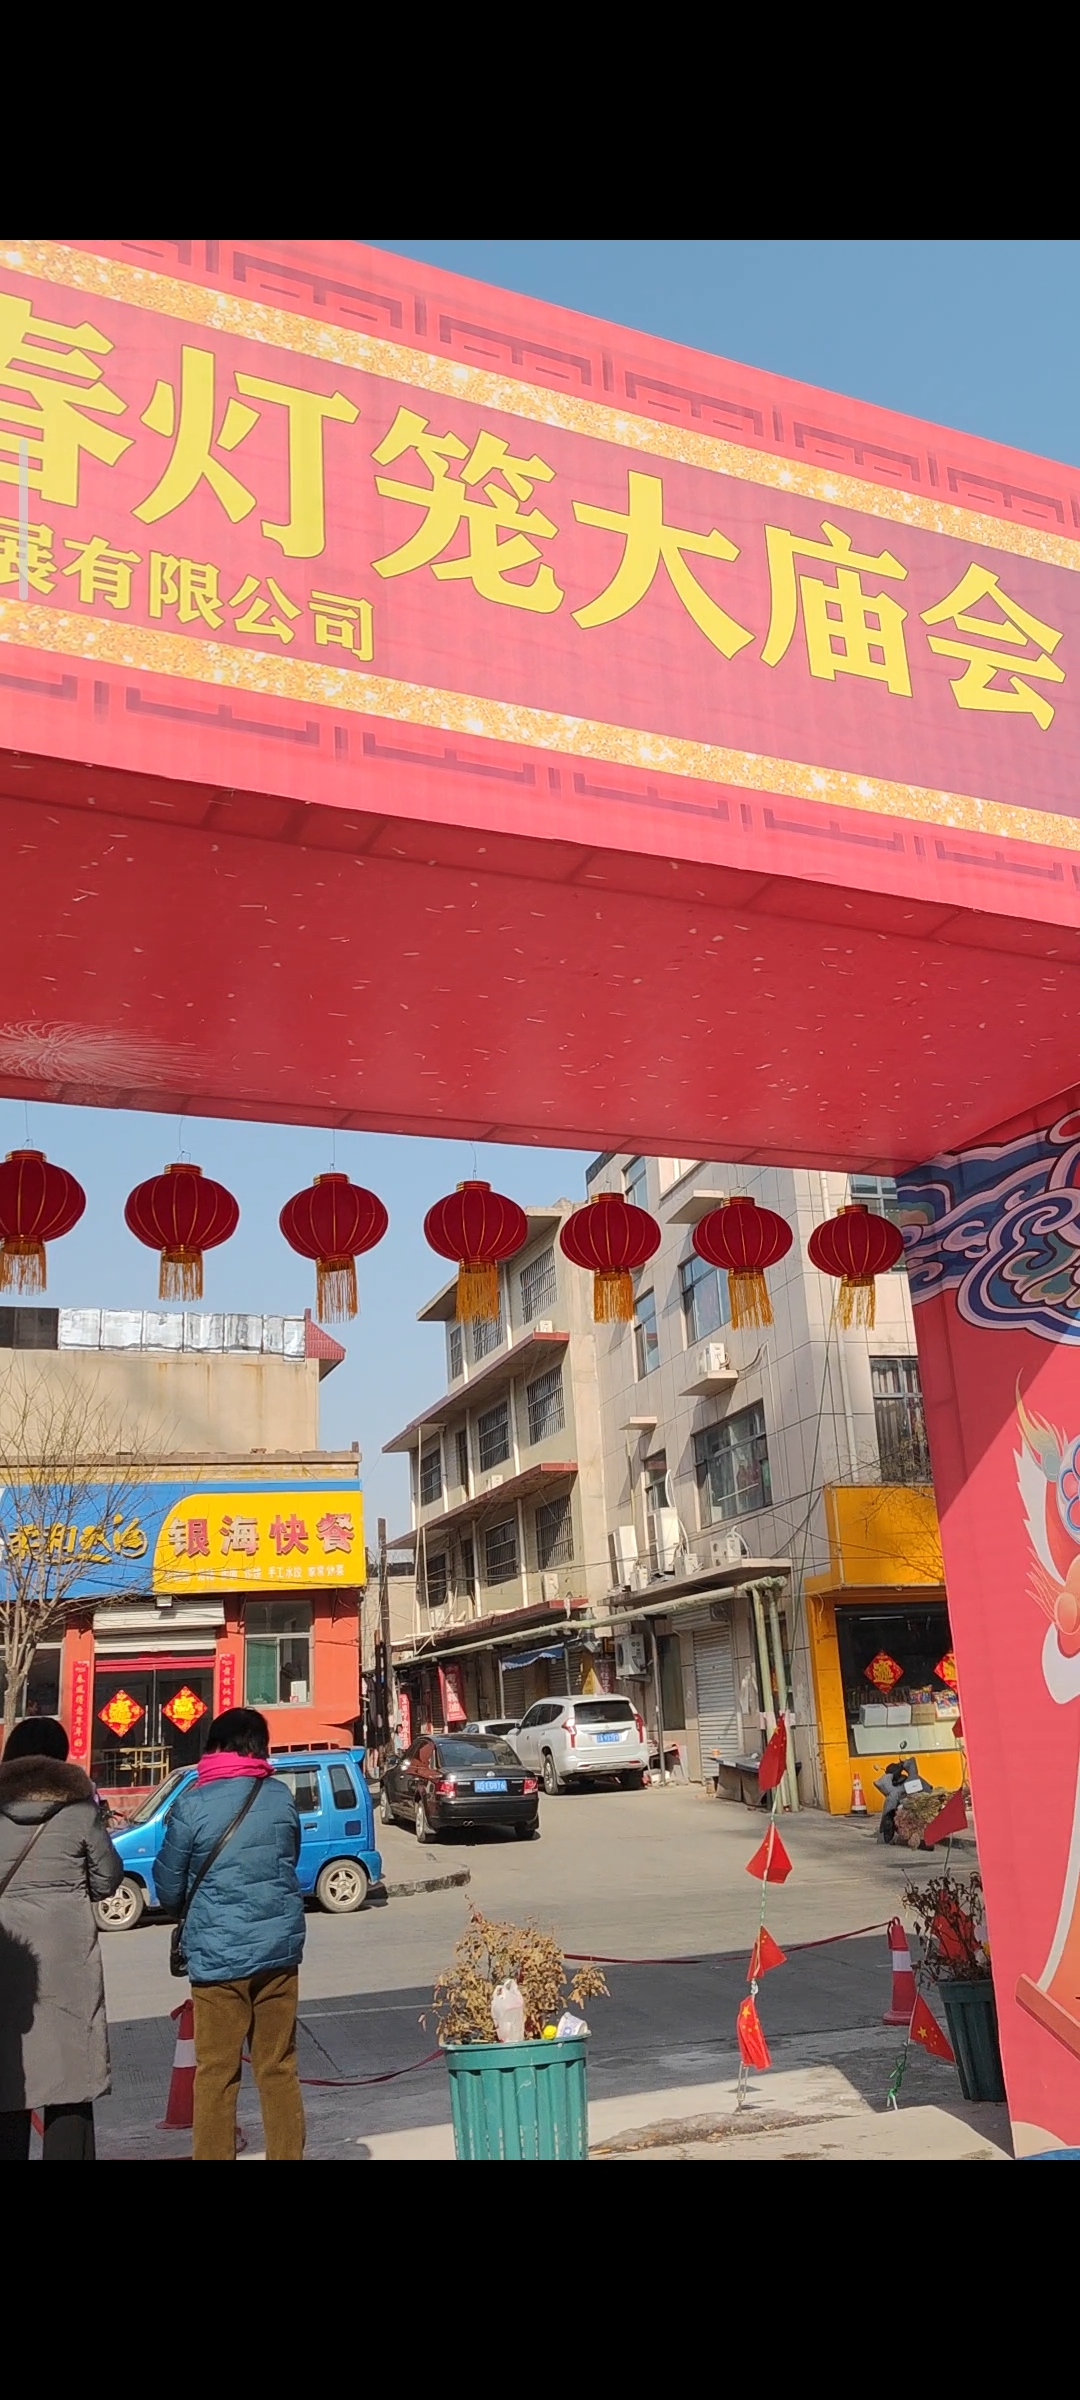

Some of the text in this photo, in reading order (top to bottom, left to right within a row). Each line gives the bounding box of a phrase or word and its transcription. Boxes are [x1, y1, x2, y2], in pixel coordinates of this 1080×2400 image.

[0, 291, 1066, 731] 春灯笼大庙会
[0, 516, 375, 662] 展有限公司
[168, 1512, 355, 1558] 银海快餐
